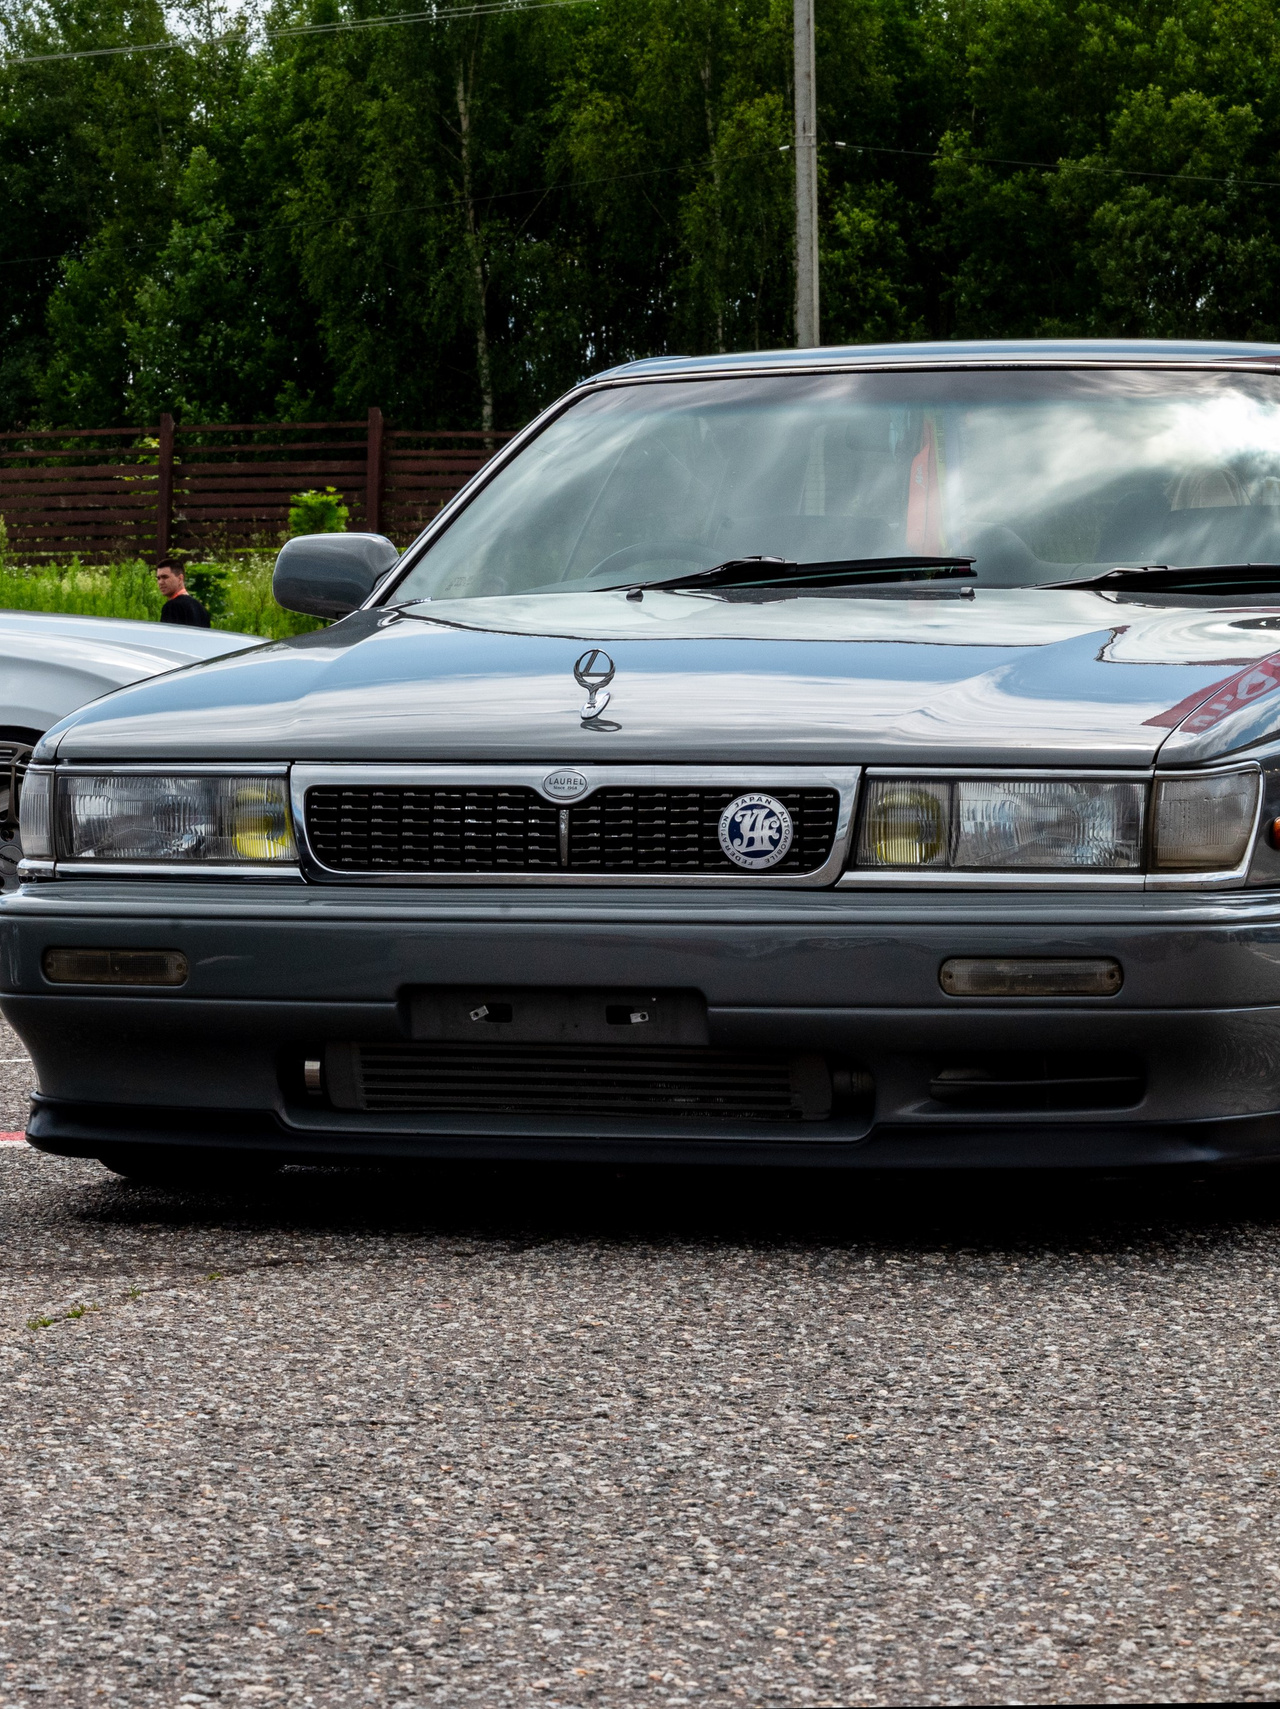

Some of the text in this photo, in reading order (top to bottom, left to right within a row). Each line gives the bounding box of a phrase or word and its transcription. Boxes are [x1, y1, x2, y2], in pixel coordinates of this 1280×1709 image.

[548, 777, 584, 786] LAUREL
[735, 796, 772, 808] JAPAN
[721, 815, 754, 866] FEDERATION
[765, 811, 791, 864] AUTOMOBILE
